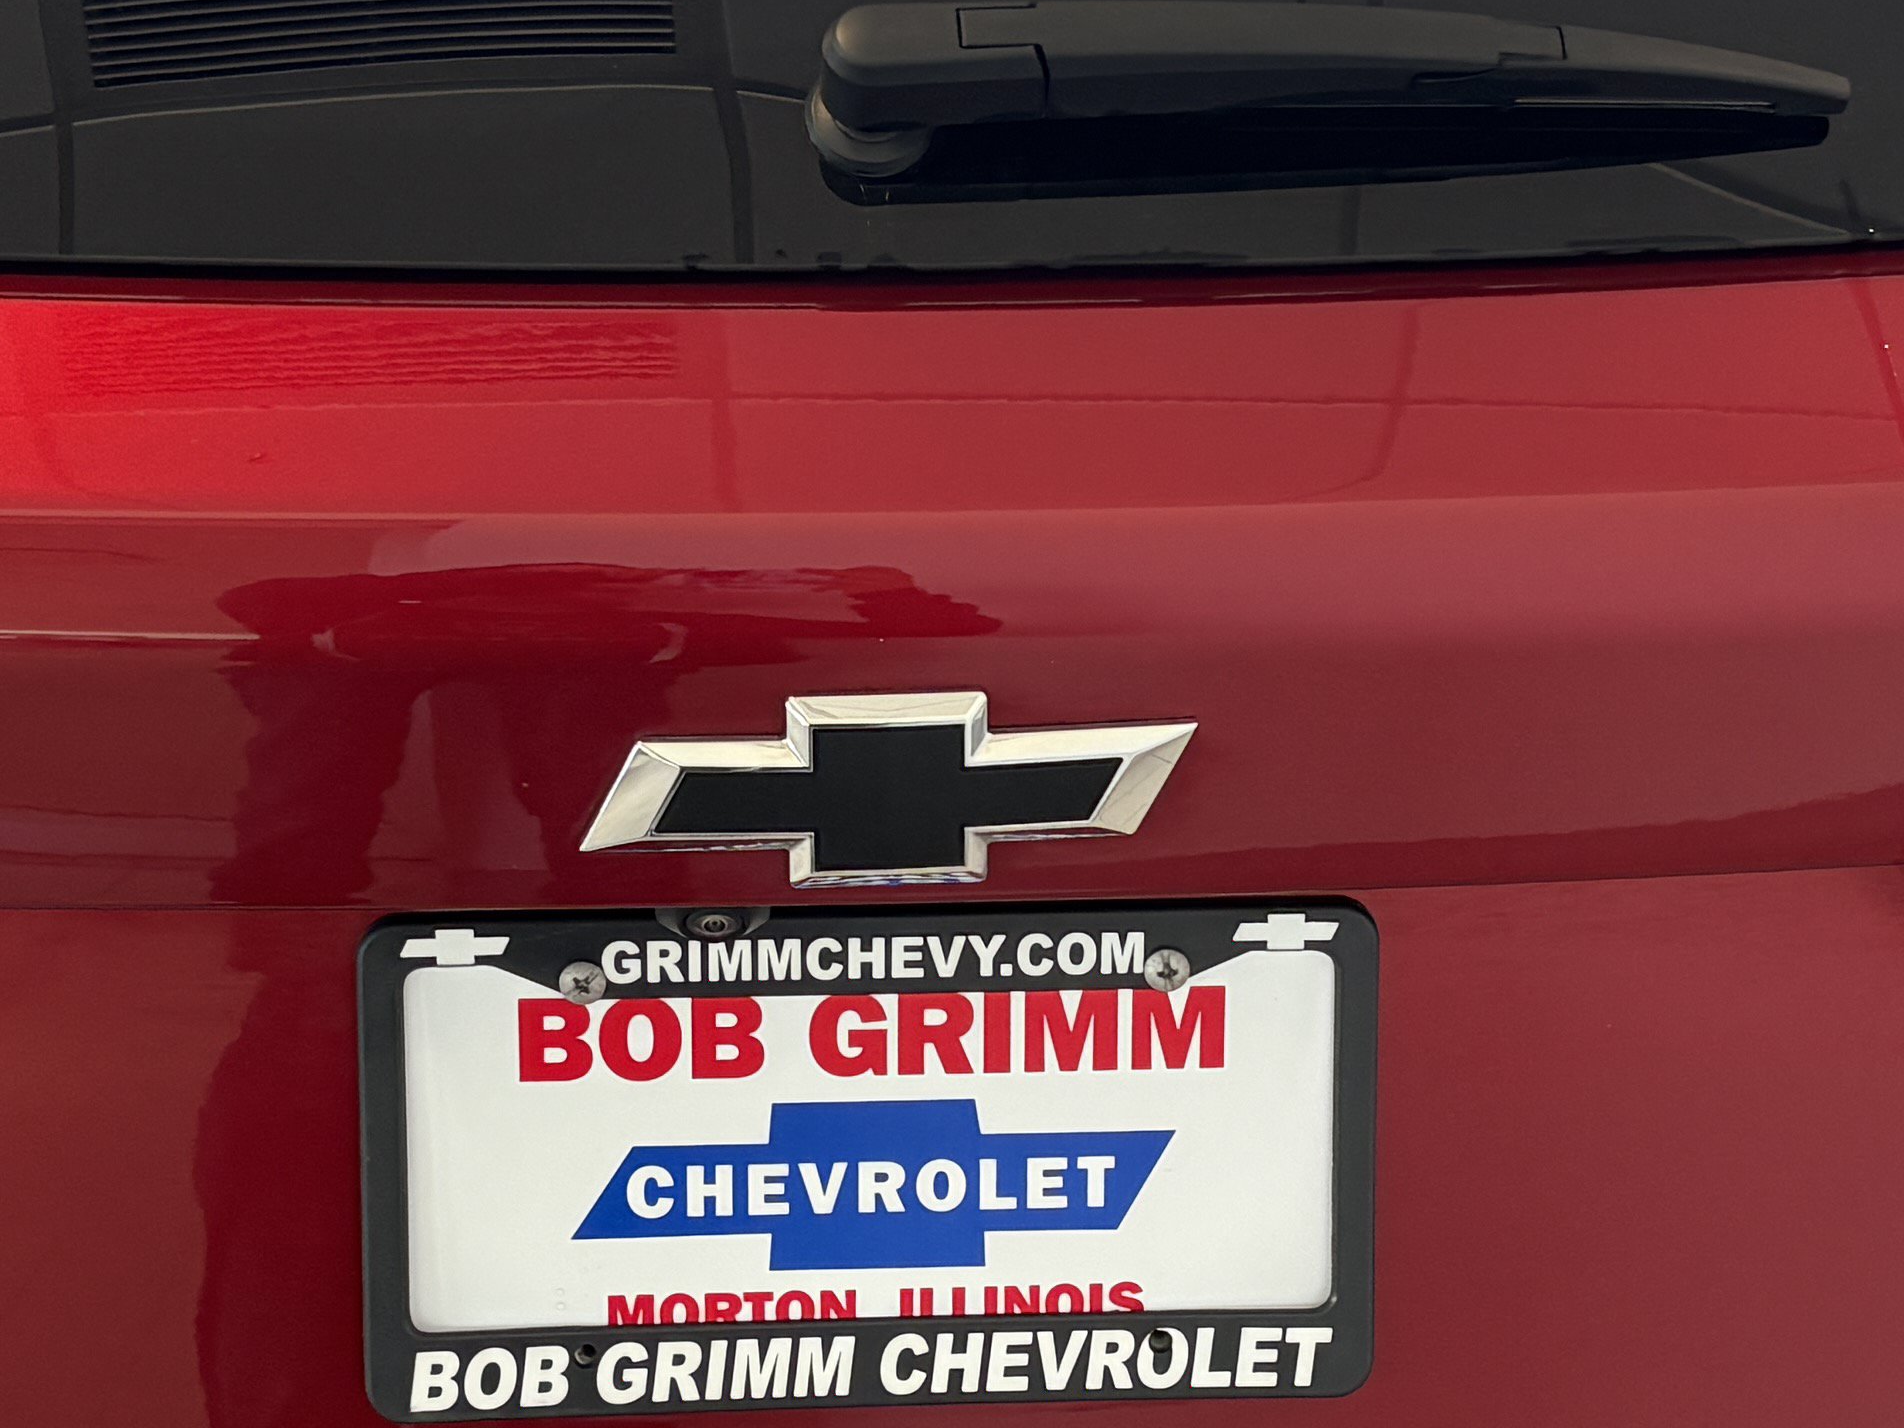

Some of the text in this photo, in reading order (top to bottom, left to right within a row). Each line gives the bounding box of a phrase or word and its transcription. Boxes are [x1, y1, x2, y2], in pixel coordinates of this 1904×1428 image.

[602, 932, 1144, 984] GRIMMCHEVY.COM
[518, 986, 1226, 1082] BOB GRIMM
[627, 1156, 1116, 1218] CHEVROLET
[607, 1281, 1145, 1327] MORTON ILLINOIS
[409, 1327, 1333, 1412] BOB GRIMM CHEVROLET
